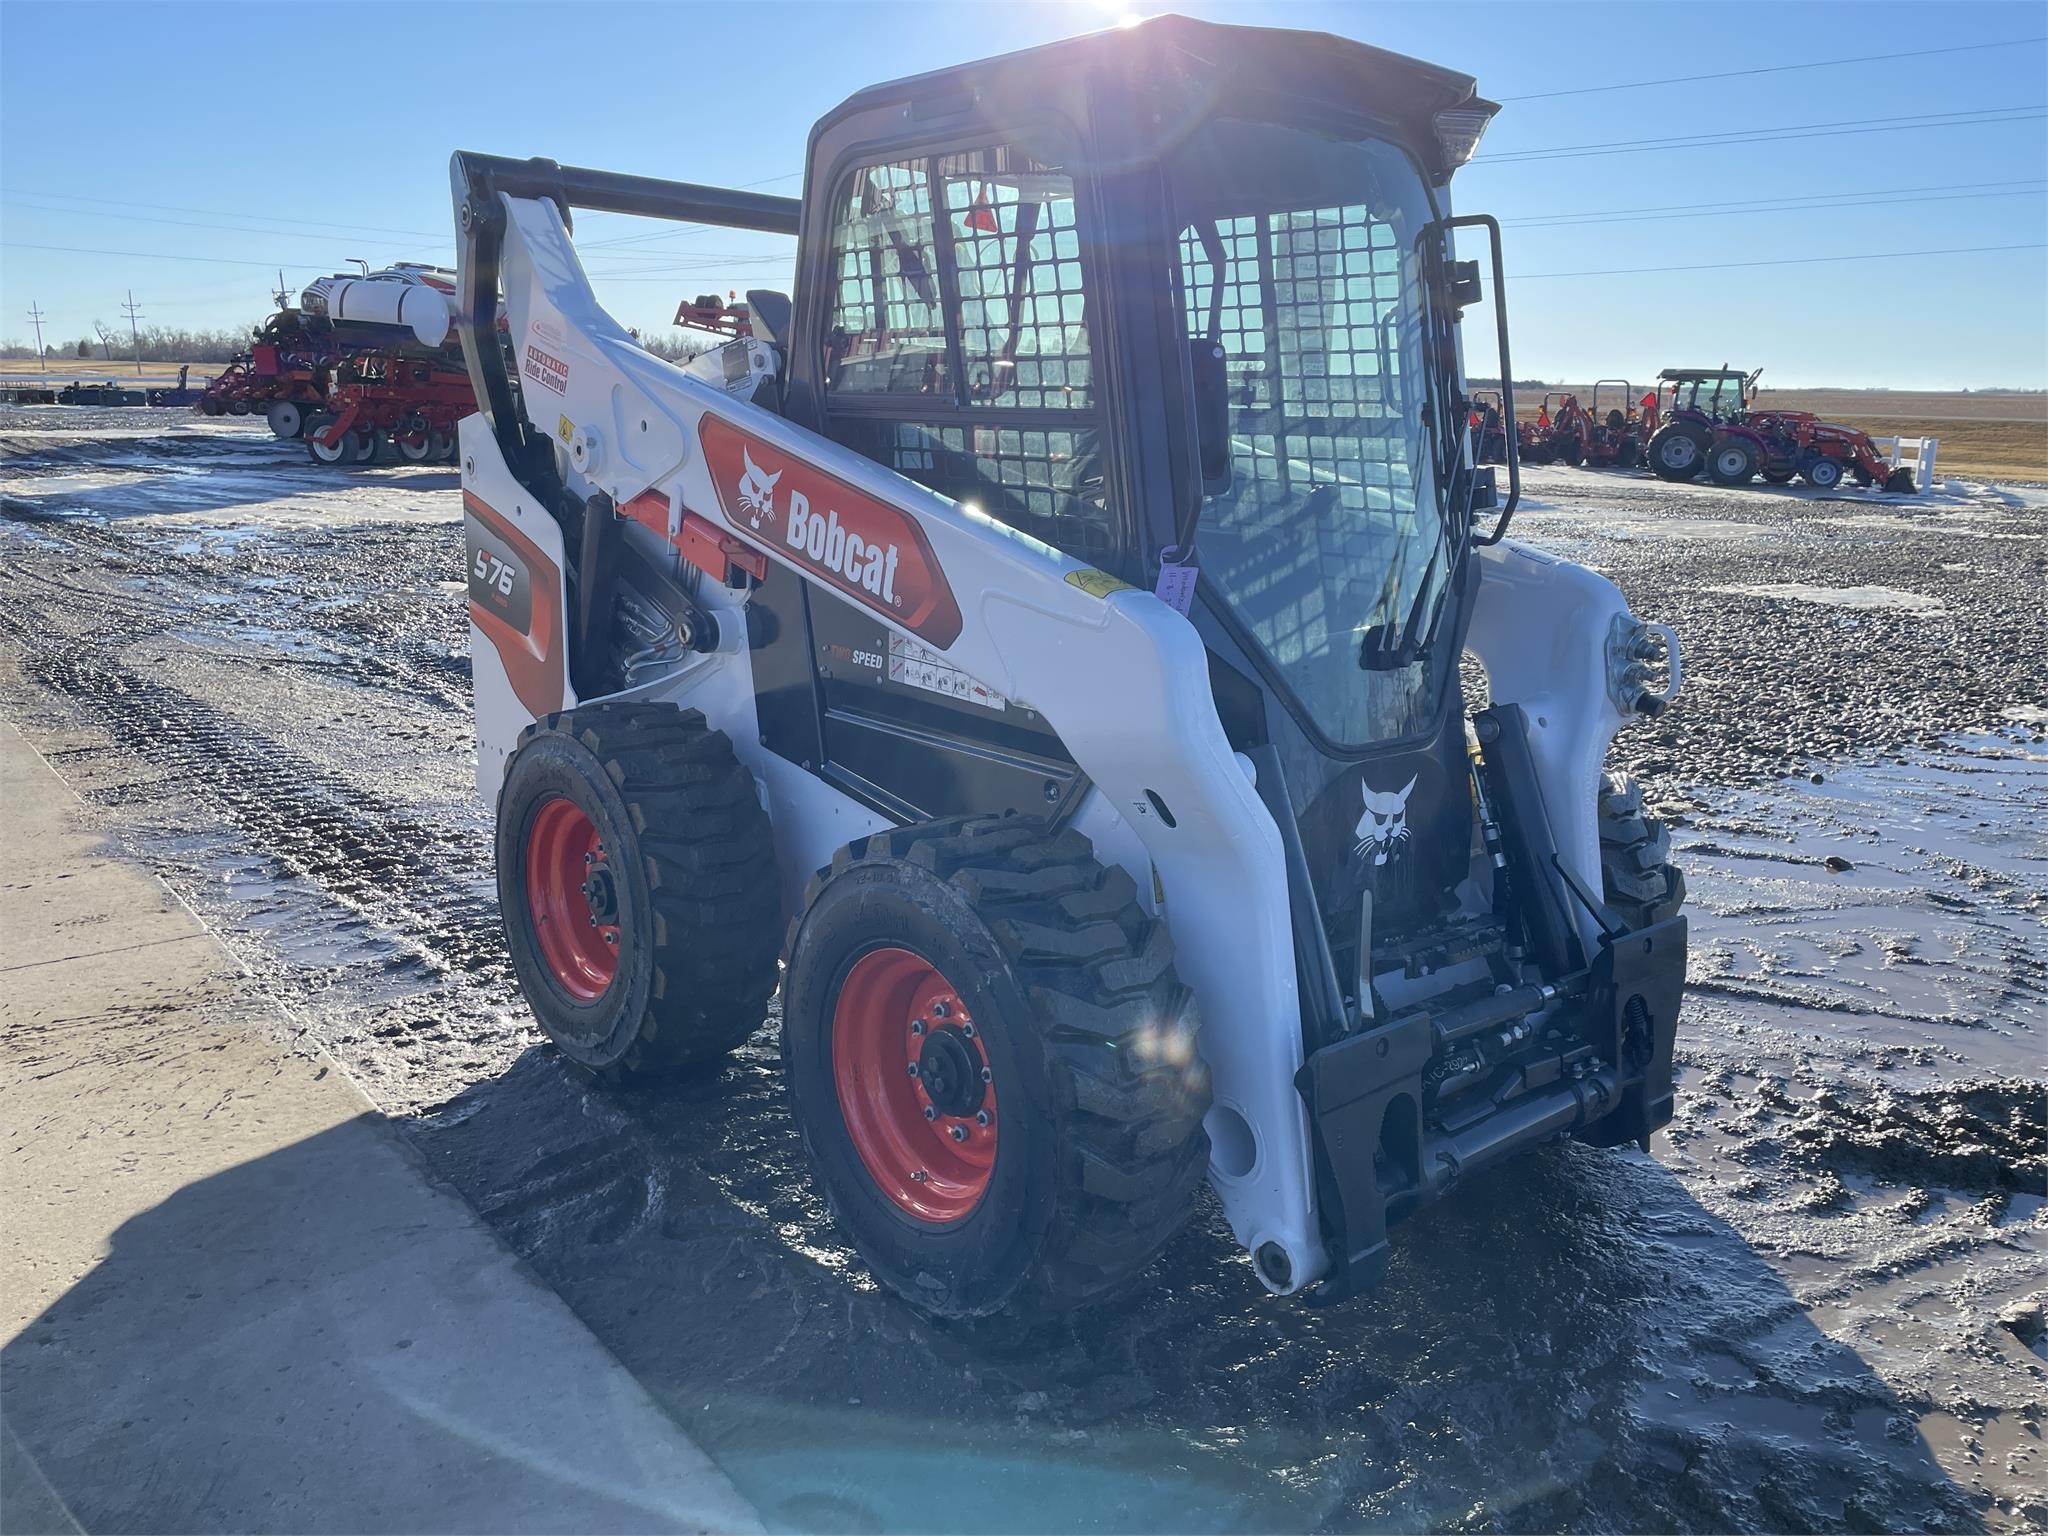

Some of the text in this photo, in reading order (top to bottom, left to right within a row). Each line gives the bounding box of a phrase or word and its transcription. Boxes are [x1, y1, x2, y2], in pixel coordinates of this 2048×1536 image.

[525, 359, 568, 393] Ride Control
[528, 346, 569, 377] AUTOMATIC
[786, 489, 899, 604] Bobcat
[852, 650, 883, 669] SPEED
